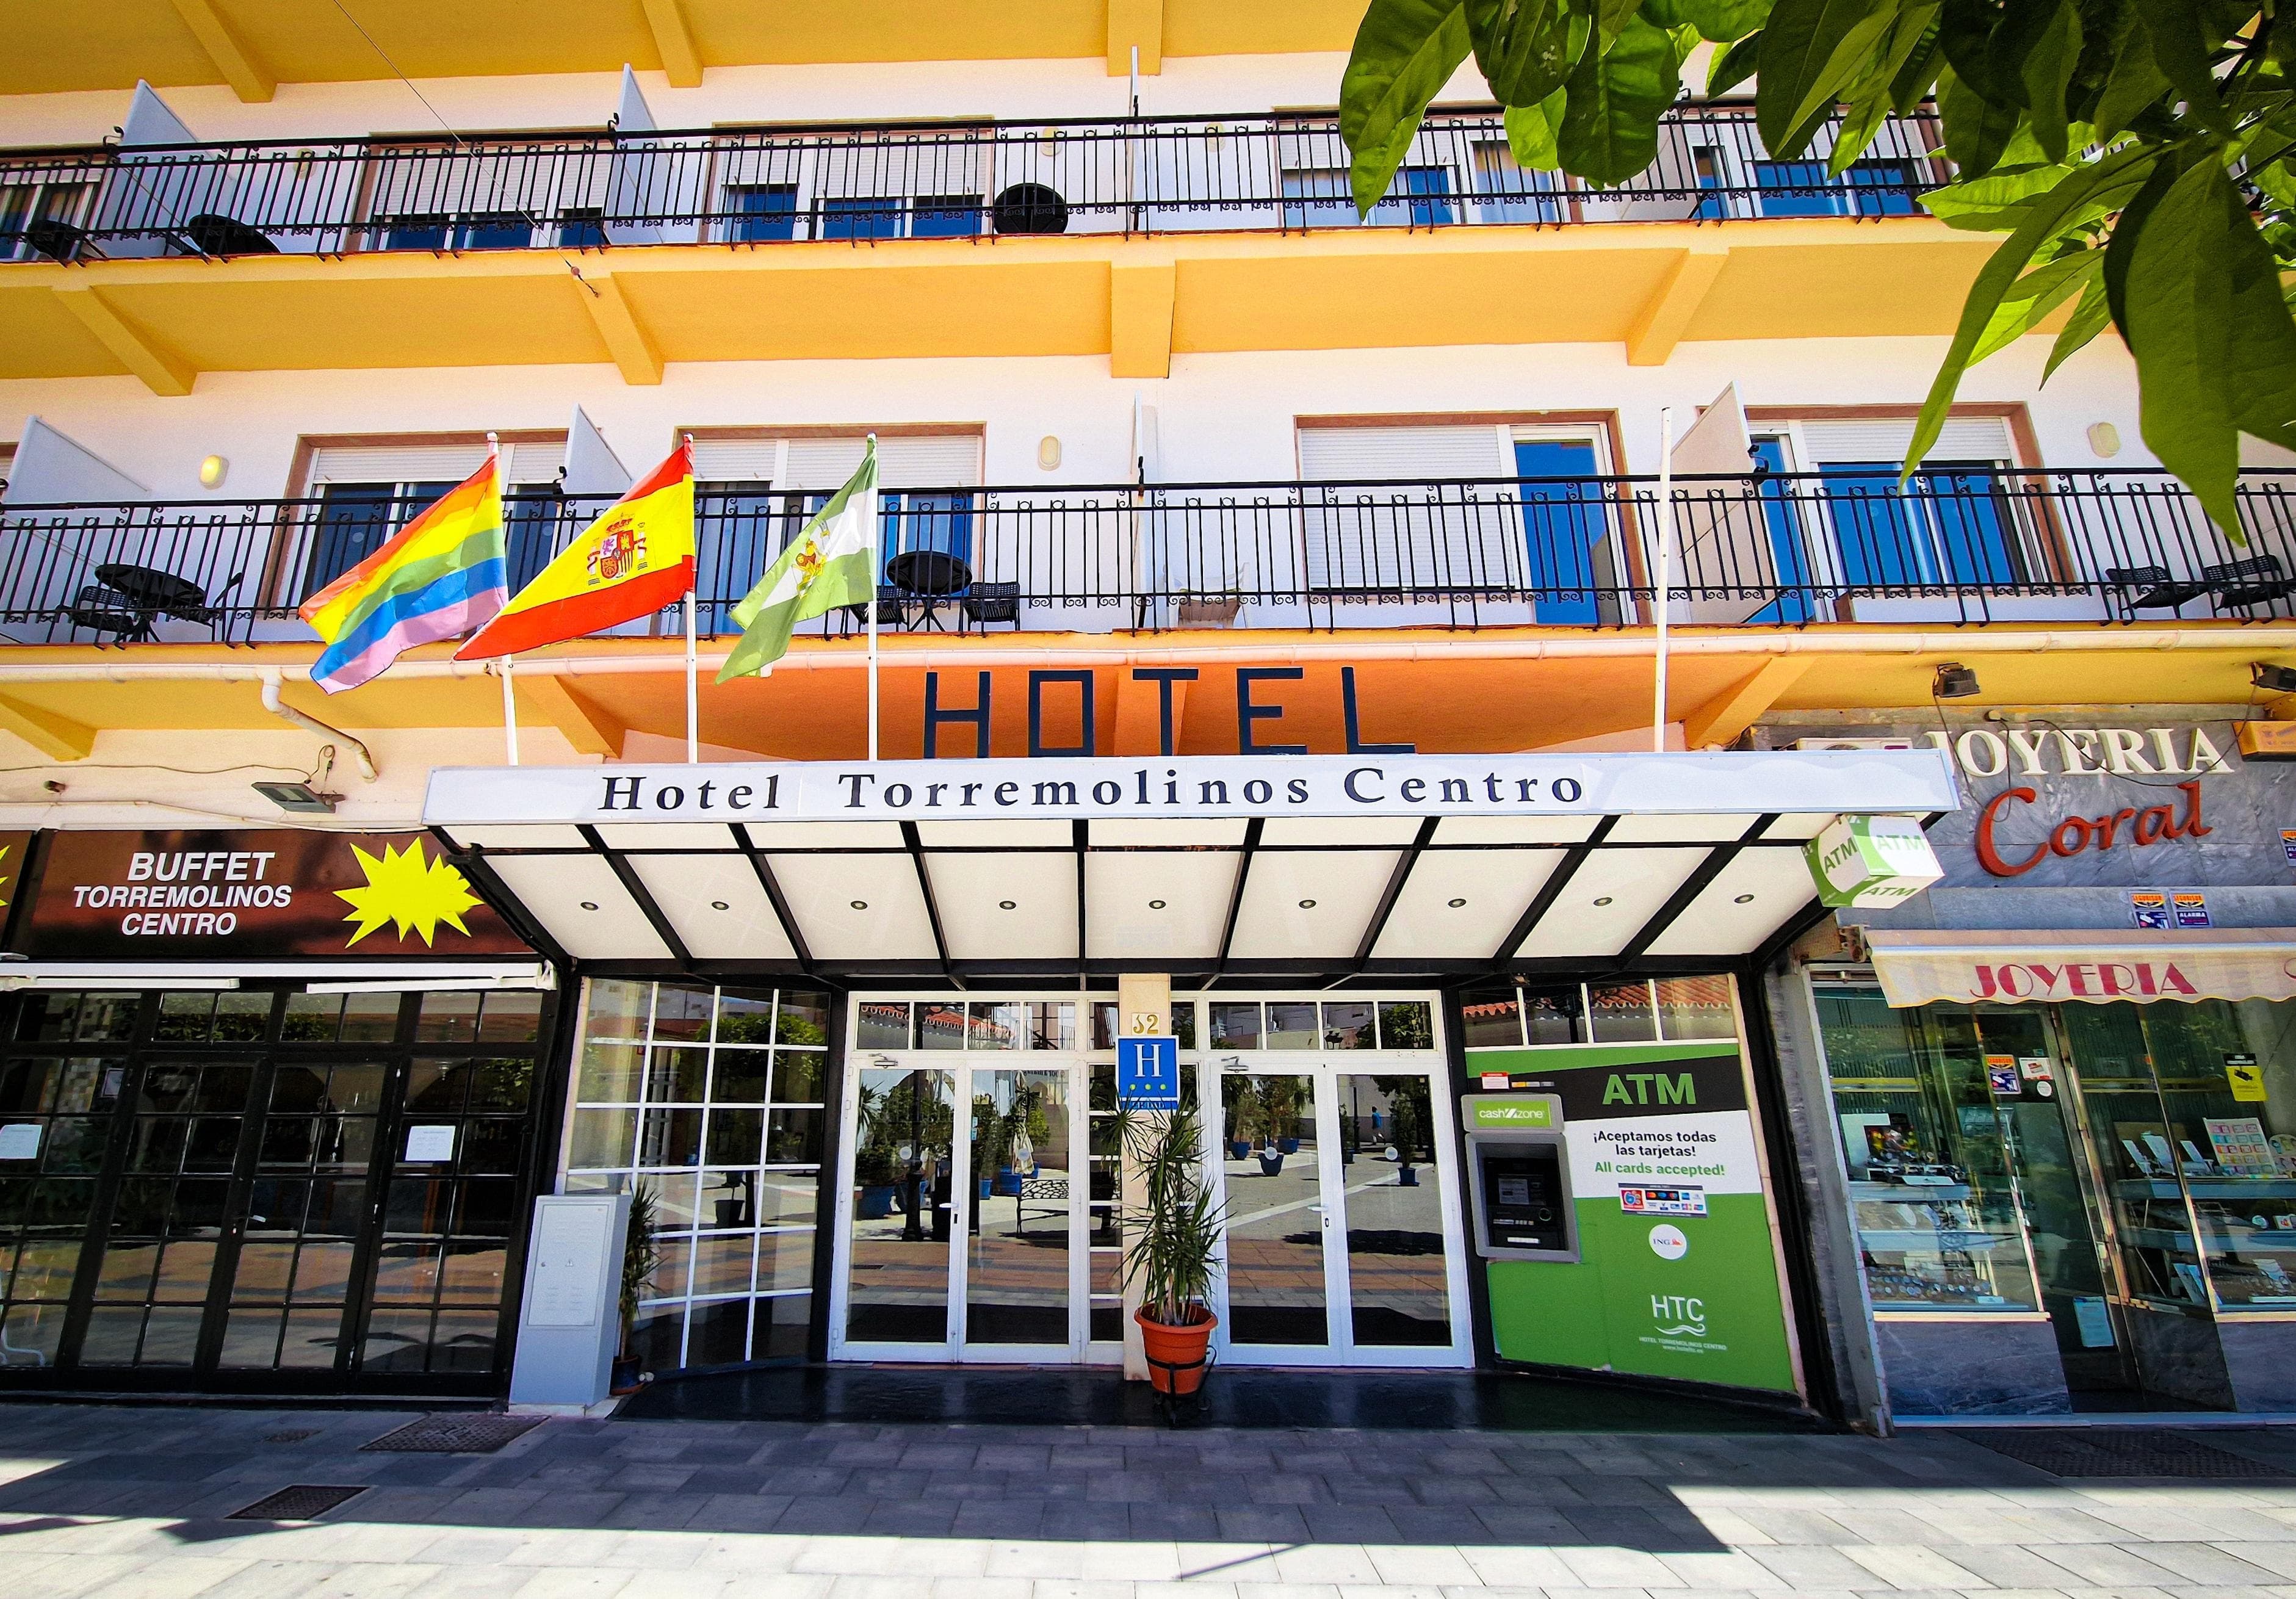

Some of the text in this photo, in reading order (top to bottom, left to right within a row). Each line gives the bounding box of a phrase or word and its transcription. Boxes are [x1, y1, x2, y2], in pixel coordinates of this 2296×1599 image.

[923, 666, 1416, 759] HOTEL
[598, 767, 1583, 810] Hotel Torremolinos Centro
[1876, 835, 1926, 850] ATM
[1974, 781, 2213, 877] Coral
[128, 852, 275, 881] BUFFET
[1824, 837, 1858, 873] ATM
[73, 885, 292, 908] TORREMOLINOS
[1861, 887, 1918, 896] ATM
[121, 912, 237, 936] CENTRO
[1970, 962, 2199, 997] JOYERIA
[1134, 1044, 1162, 1077] H
[1602, 1073, 1697, 1105] ATM
[1594, 1130, 1716, 1144] ¡Aceptamos todas
[1616, 1144, 1696, 1158] las tarjetas!
[1595, 1161, 1725, 1177] All cards accepted!
[1650, 1294, 1705, 1321] HTC
